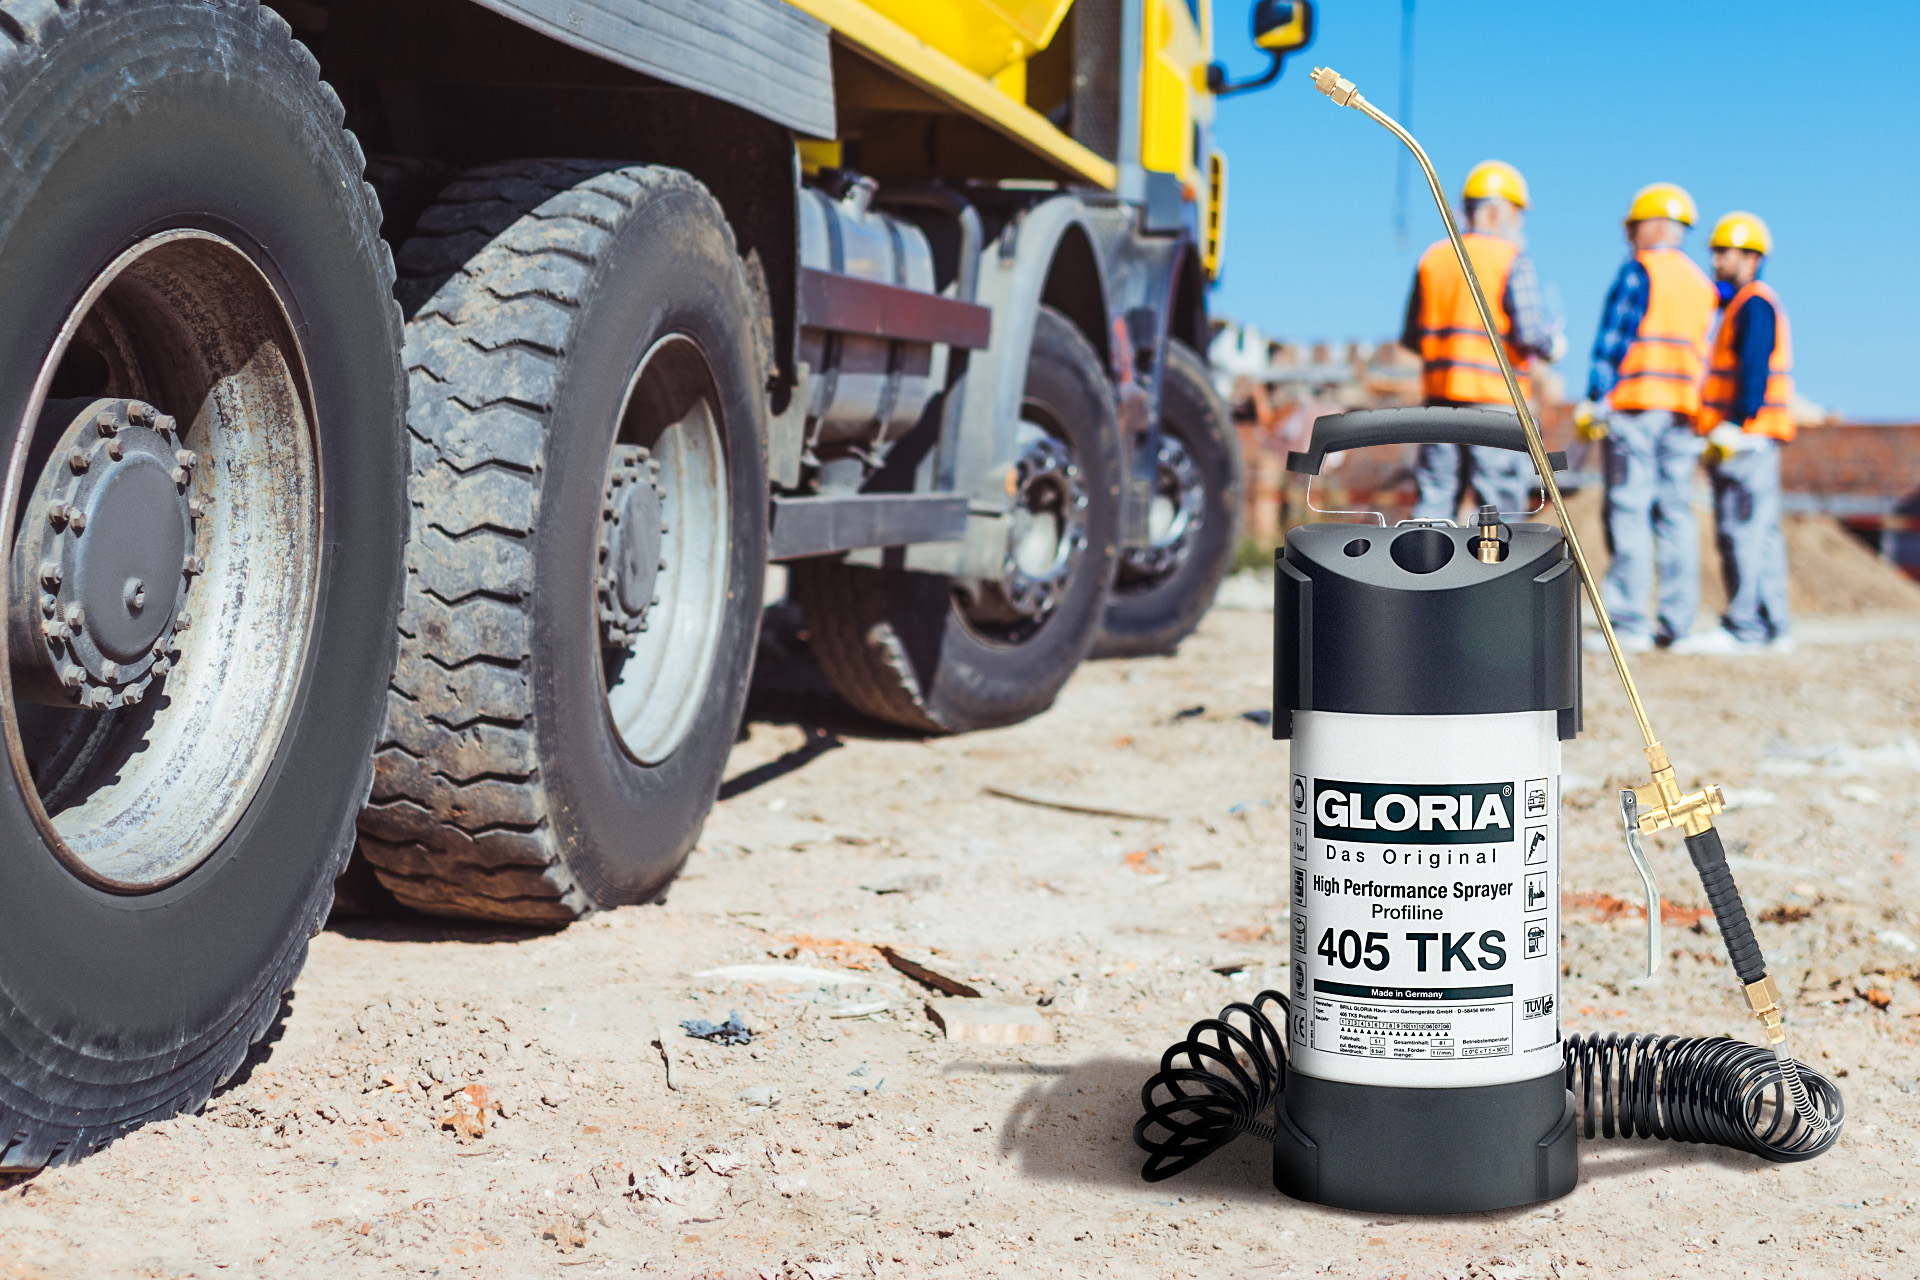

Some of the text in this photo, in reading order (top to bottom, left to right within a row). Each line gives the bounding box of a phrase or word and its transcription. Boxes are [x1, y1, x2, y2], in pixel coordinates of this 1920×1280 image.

[1316, 790, 1511, 832] GLORIA
[1326, 845, 1496, 868] Das Original
[1313, 874, 1513, 902] High Performance Sprayer
[1372, 904, 1444, 920] Profiline
[1317, 928, 1507, 972] 405 TKS
[1371, 988, 1443, 1000] Made in Germany
[1525, 999, 1542, 1012] TÜV
